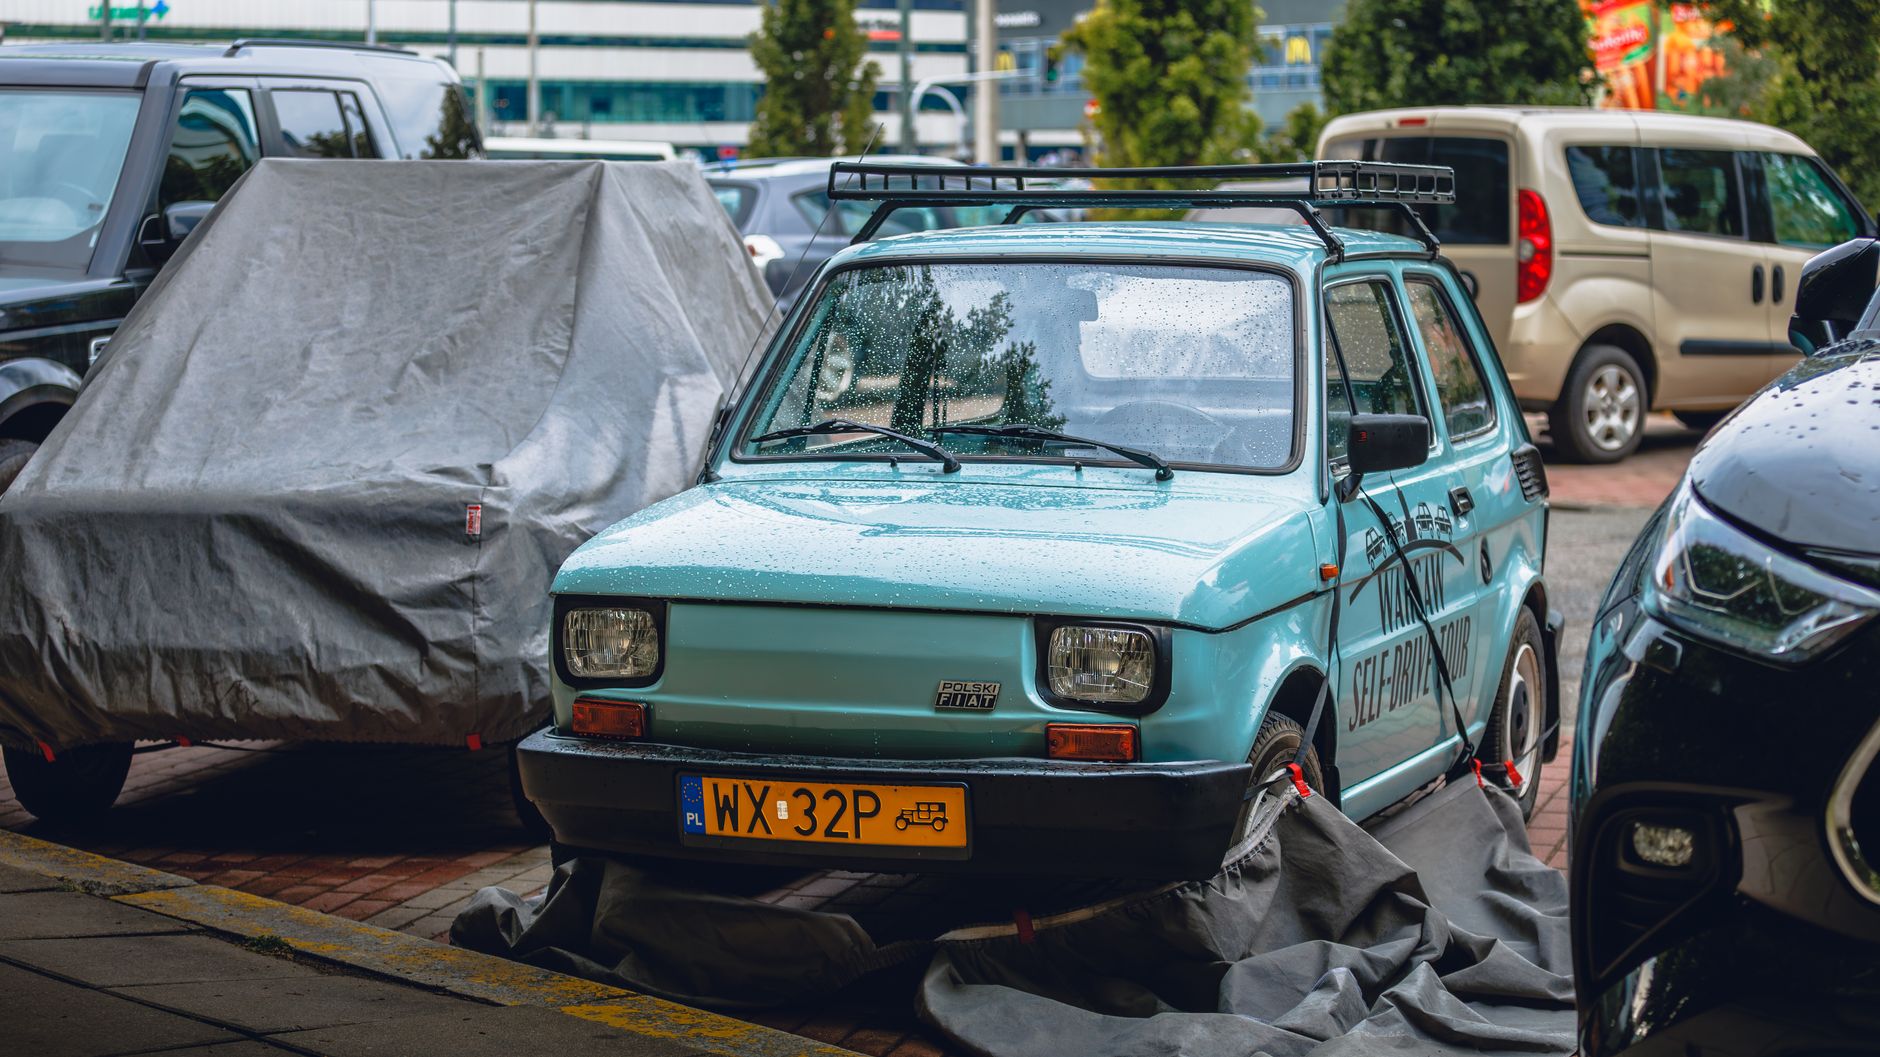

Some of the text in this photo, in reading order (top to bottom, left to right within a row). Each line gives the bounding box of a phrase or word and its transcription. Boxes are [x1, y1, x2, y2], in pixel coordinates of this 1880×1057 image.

[1349, 615, 1471, 732] SELF-DRIVE TOUR
[942, 682, 997, 694] POLSKI
[939, 693, 994, 707] FIAT
[712, 783, 882, 840] WX 32P
[686, 812, 703, 827] PL
